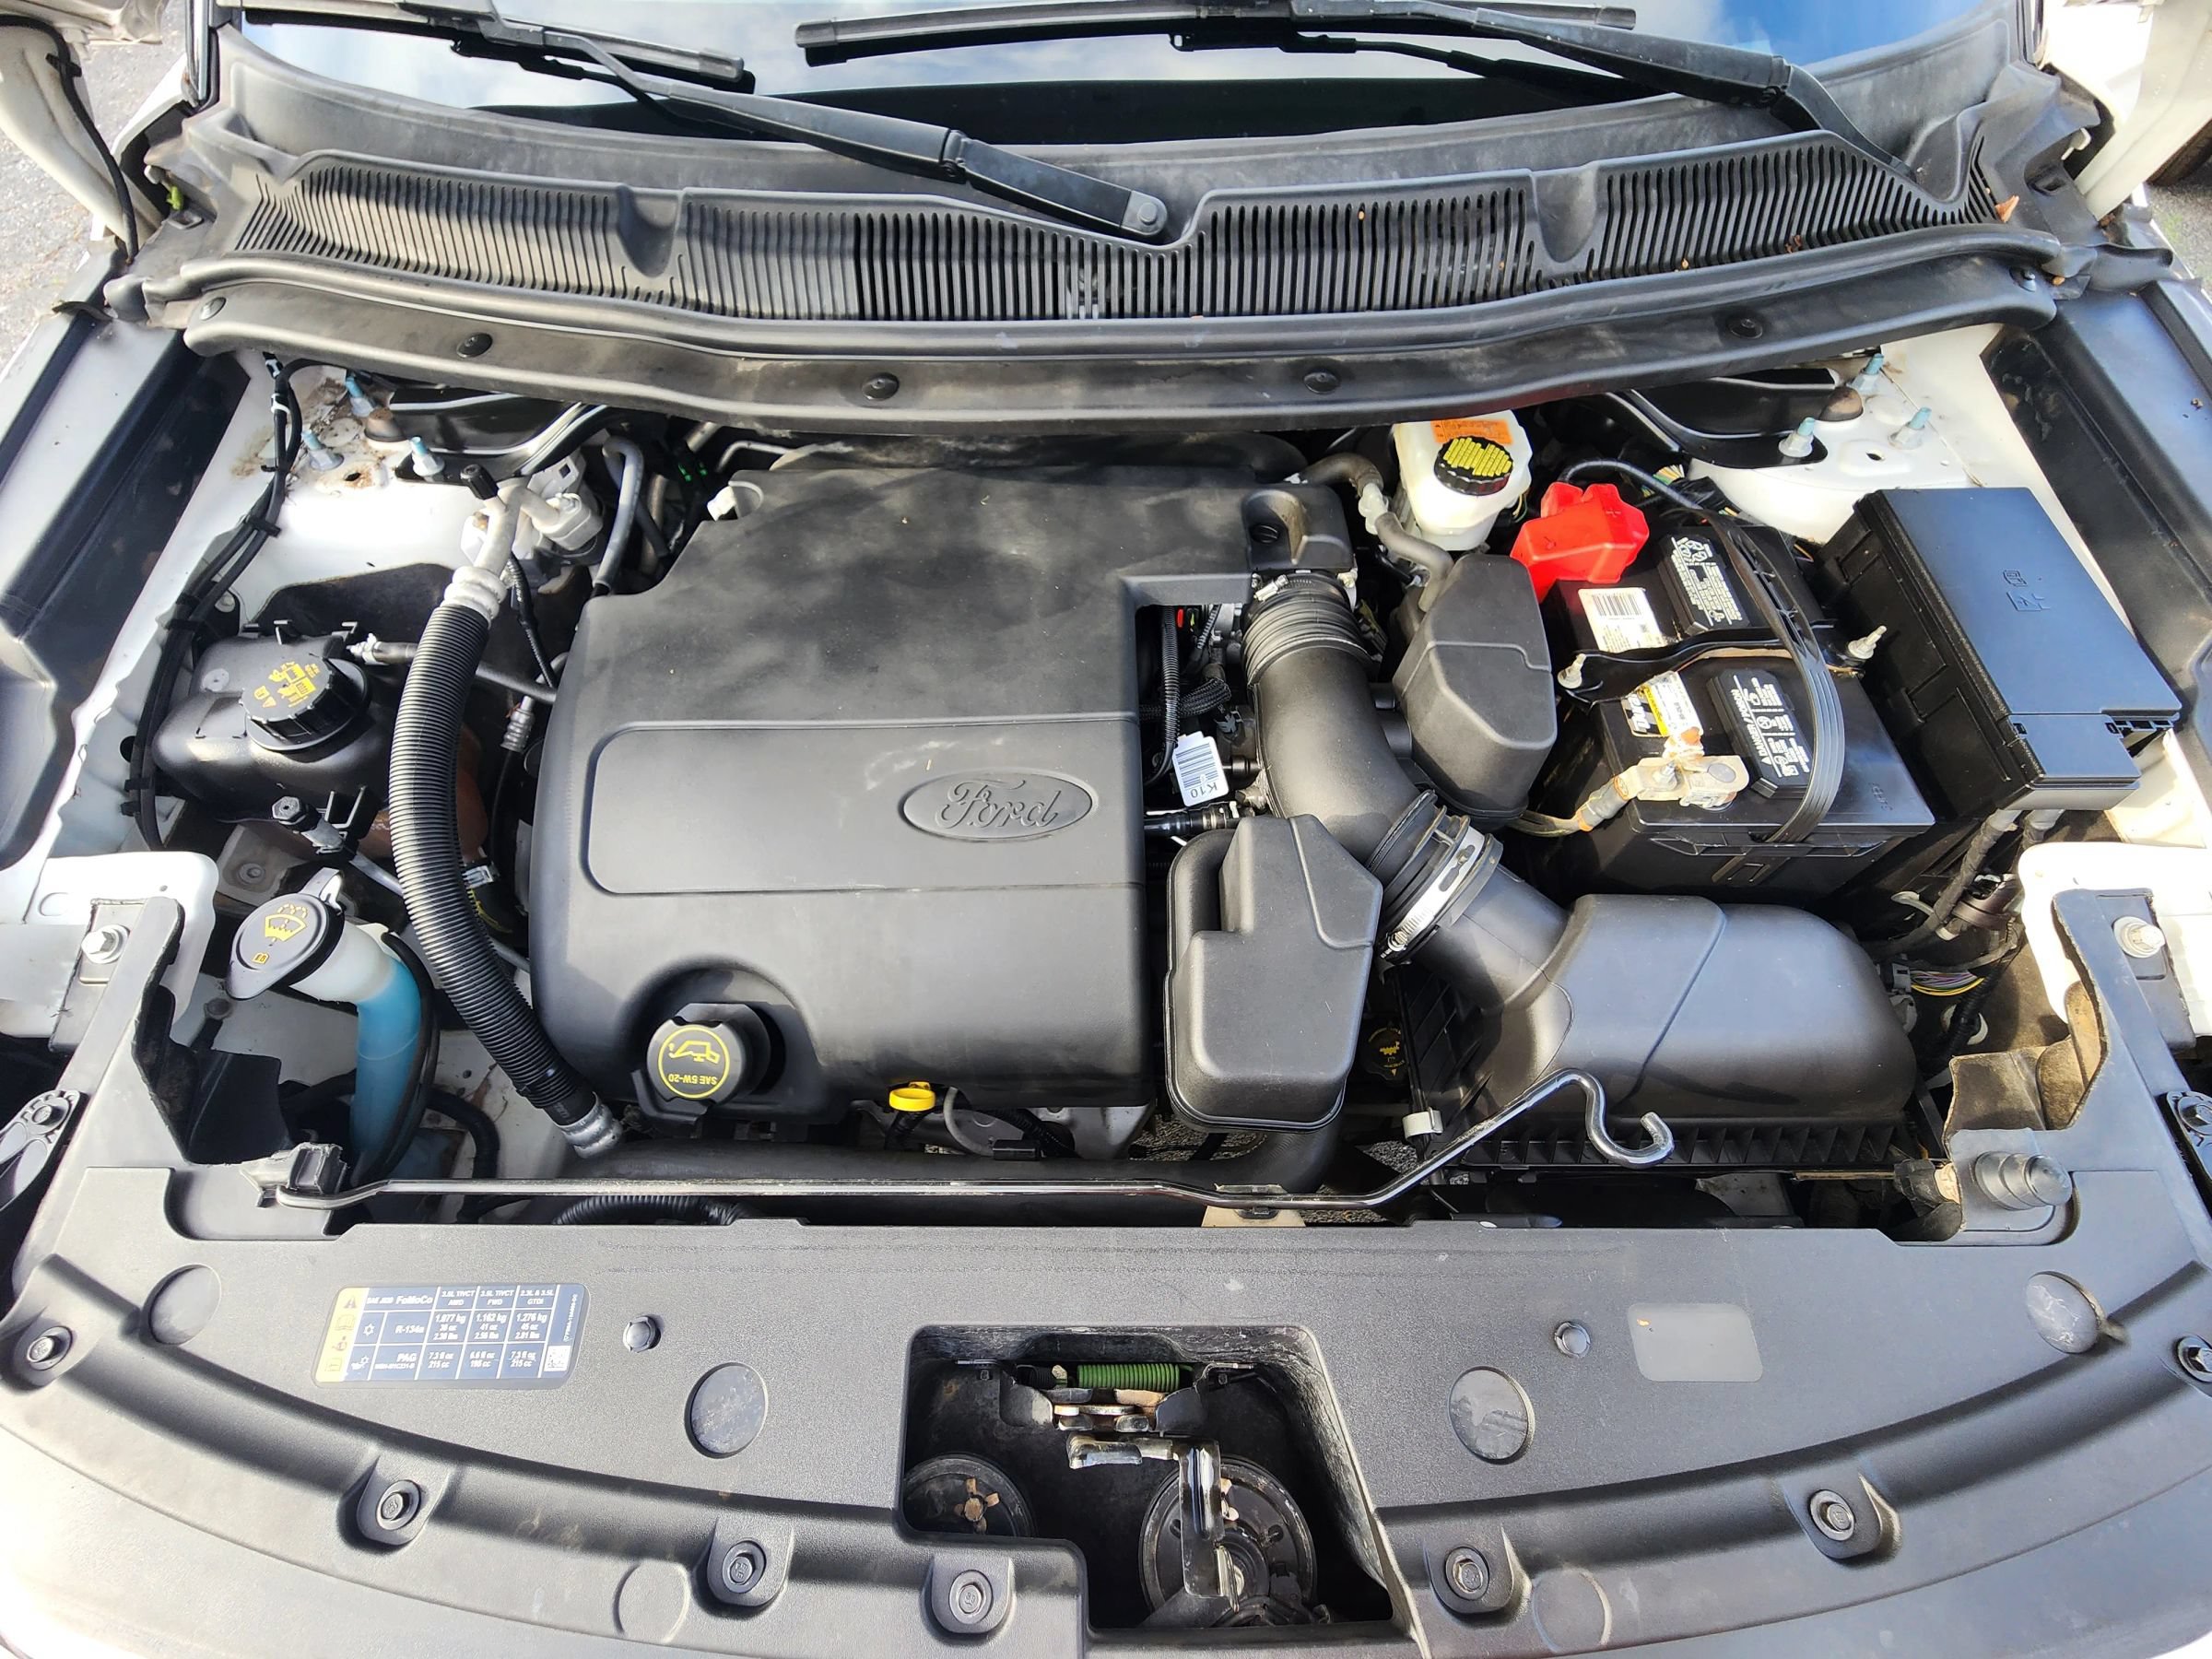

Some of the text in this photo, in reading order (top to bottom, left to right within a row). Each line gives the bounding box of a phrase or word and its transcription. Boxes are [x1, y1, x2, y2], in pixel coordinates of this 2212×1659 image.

[1731, 688, 1751, 718] POISON
[1747, 724, 1769, 757] DANGER
[1190, 782, 1218, 798] K10
[935, 780, 1062, 829] Ford
[668, 1073, 718, 1086] SAE 5W-20
[395, 1295, 433, 1304] FoMoCo
[455, 1313, 466, 1324] kg
[496, 1313, 508, 1324] kg
[536, 1312, 548, 1324] kg
[394, 1324, 424, 1334] R-134a
[396, 1352, 417, 1362] PAG
[428, 1359, 441, 1368] 215
[511, 1359, 524, 1368] 215
